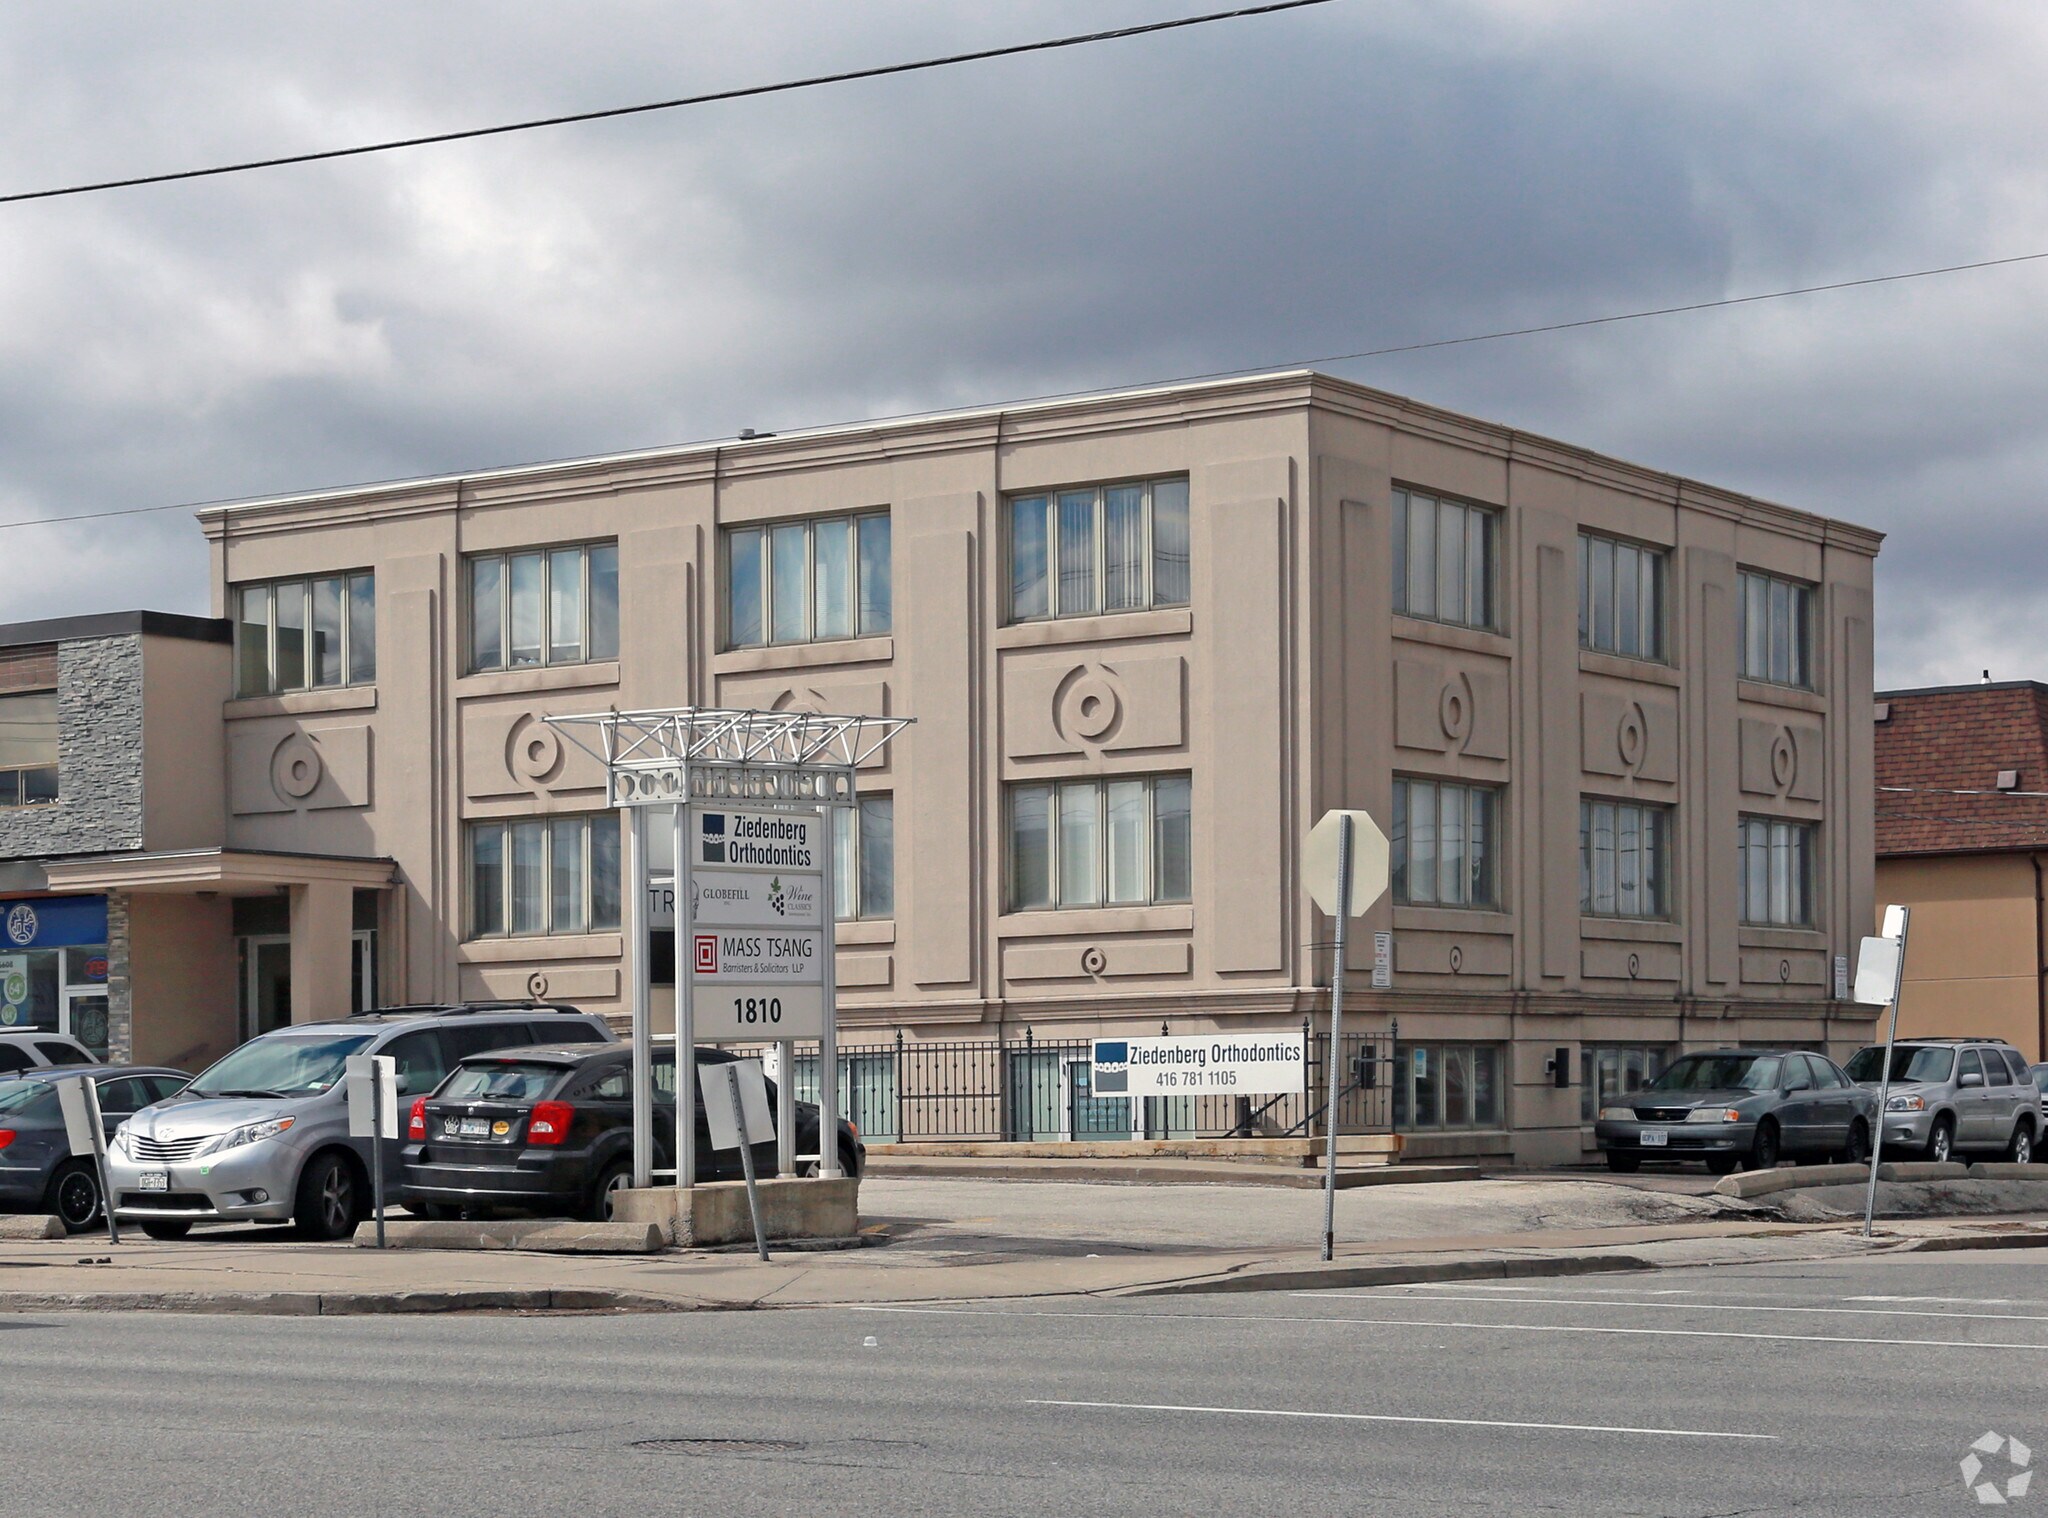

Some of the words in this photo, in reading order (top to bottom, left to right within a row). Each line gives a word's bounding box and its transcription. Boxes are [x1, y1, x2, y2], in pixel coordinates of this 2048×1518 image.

[734, 815, 806, 845] Ziedenberg
[729, 841, 811, 866] Orthodontics
[703, 888, 749, 900] GLOBEFILL
[786, 885, 813, 901] Wine
[787, 903, 812, 911] CLASSICS
[723, 937, 761, 957] MASS
[766, 938, 812, 957] TSANG
[723, 963, 753, 973] Barristers
[754, 963, 759, 973] &
[760, 963, 788, 974] Solicitors
[792, 963, 804, 973] LLP
[734, 998, 781, 1023] 1810
[1130, 1046, 1206, 1067] Ziedenberg
[1211, 1043, 1300, 1063] Orthodontics
[1156, 1072, 1177, 1086] 416
[1182, 1071, 1203, 1086] 781
[1208, 1070, 1237, 1086] 1105
